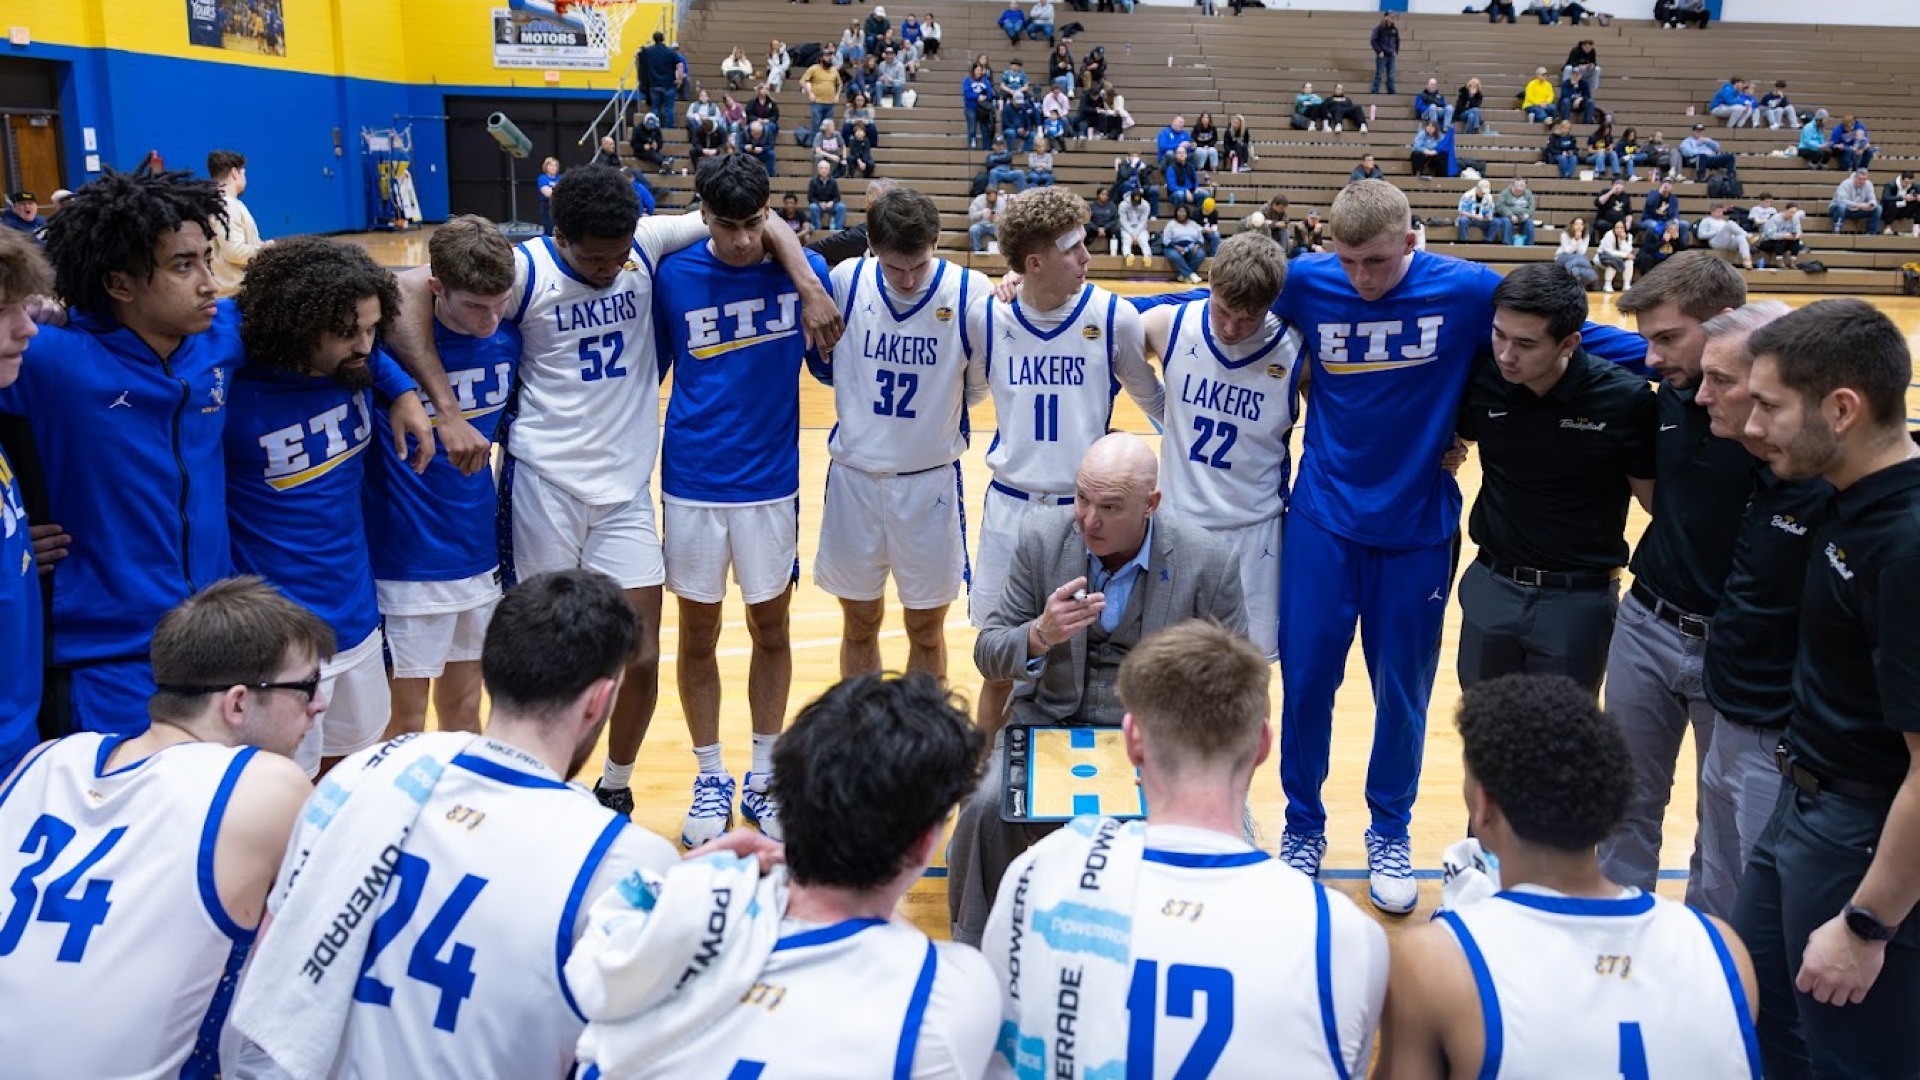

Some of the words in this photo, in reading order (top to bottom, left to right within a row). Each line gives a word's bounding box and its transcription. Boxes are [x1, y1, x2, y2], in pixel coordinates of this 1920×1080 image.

[520, 32, 577, 45] MOTORS
[555, 290, 636, 332] LAKERS
[684, 293, 799, 348] ETJ
[578, 330, 627, 382] 52
[864, 330, 938, 366] LAKERS
[1317, 315, 1444, 362] ETJ
[873, 369, 919, 419] 32
[1009, 356, 1086, 386] LAKERS
[1033, 393, 1059, 442] 11
[1181, 373, 1265, 422] LAKERS
[259, 389, 371, 478] ETJ
[1188, 415, 1238, 471] 22
[0, 813, 130, 964] 34
[353, 850, 489, 1034] 24
[1126, 958, 1234, 1080] 12
